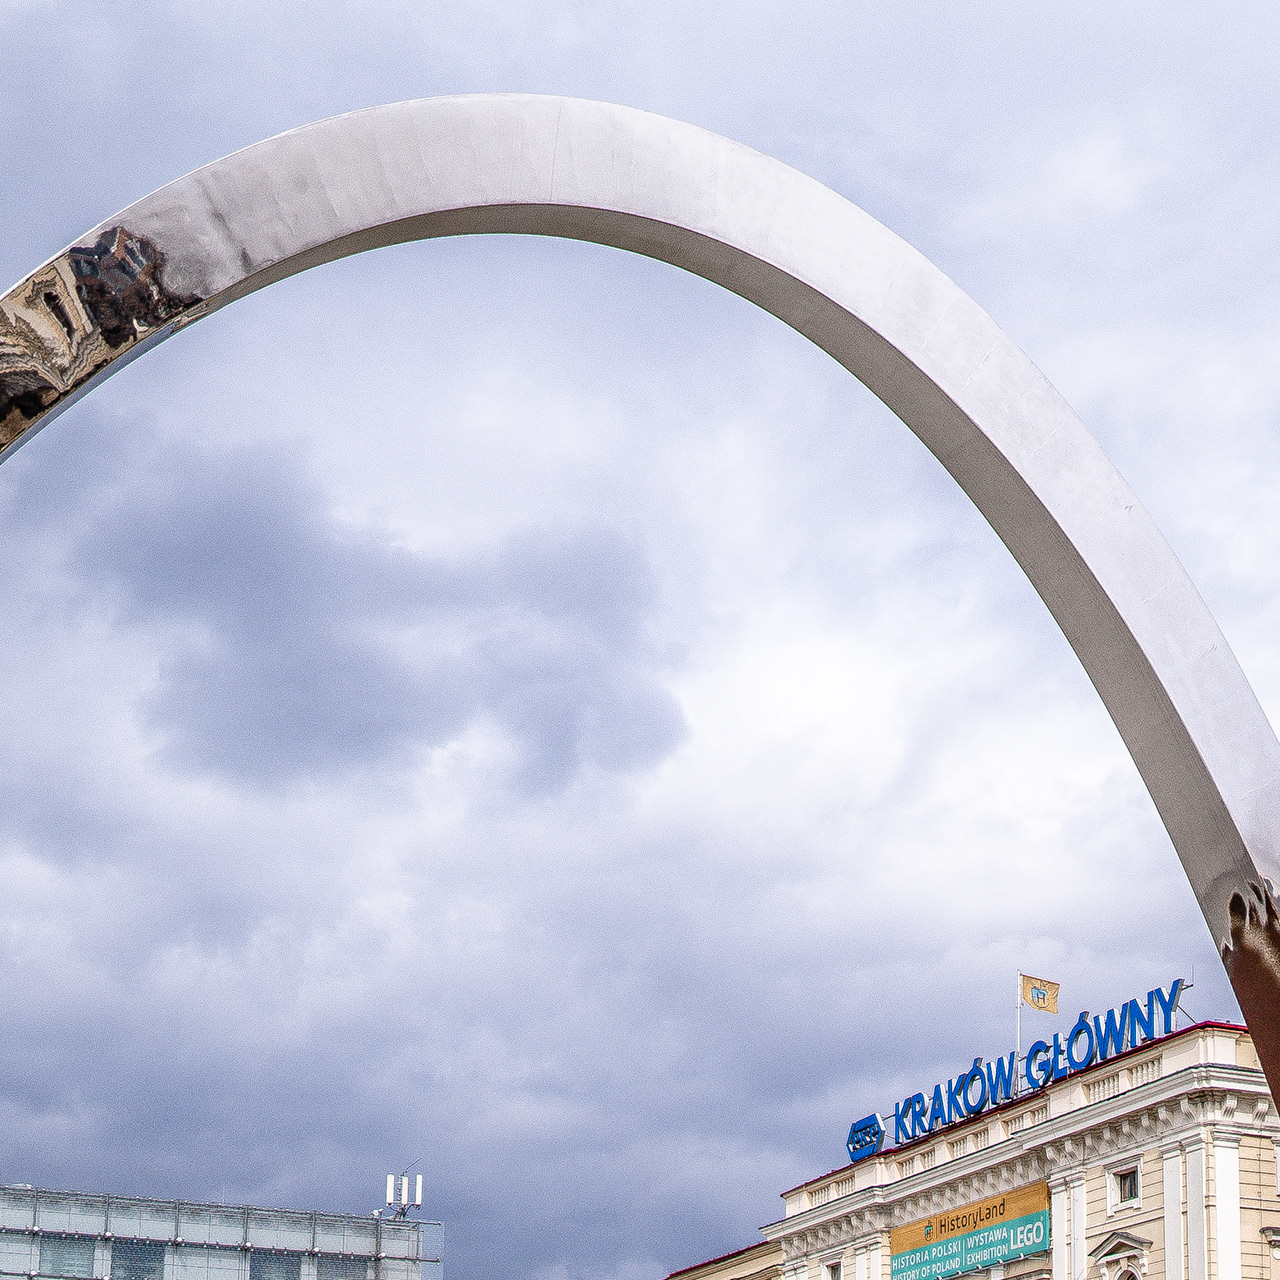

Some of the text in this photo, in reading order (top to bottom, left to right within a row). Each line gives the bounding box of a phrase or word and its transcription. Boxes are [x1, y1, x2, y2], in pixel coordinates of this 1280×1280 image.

[894, 978, 1185, 1144] KRAKÓW GŁÓWNY
[939, 1198, 1006, 1235] HistoryLand
[967, 1226, 1008, 1250] WYSTAWA
[1009, 1219, 1044, 1250] LEGO
[892, 1240, 961, 1271] HISTORIA POLSKI
[921, 1268, 931, 1278] OF
[932, 1257, 961, 1275] POLAND
[967, 1243, 1009, 1266] EXHIBITION
